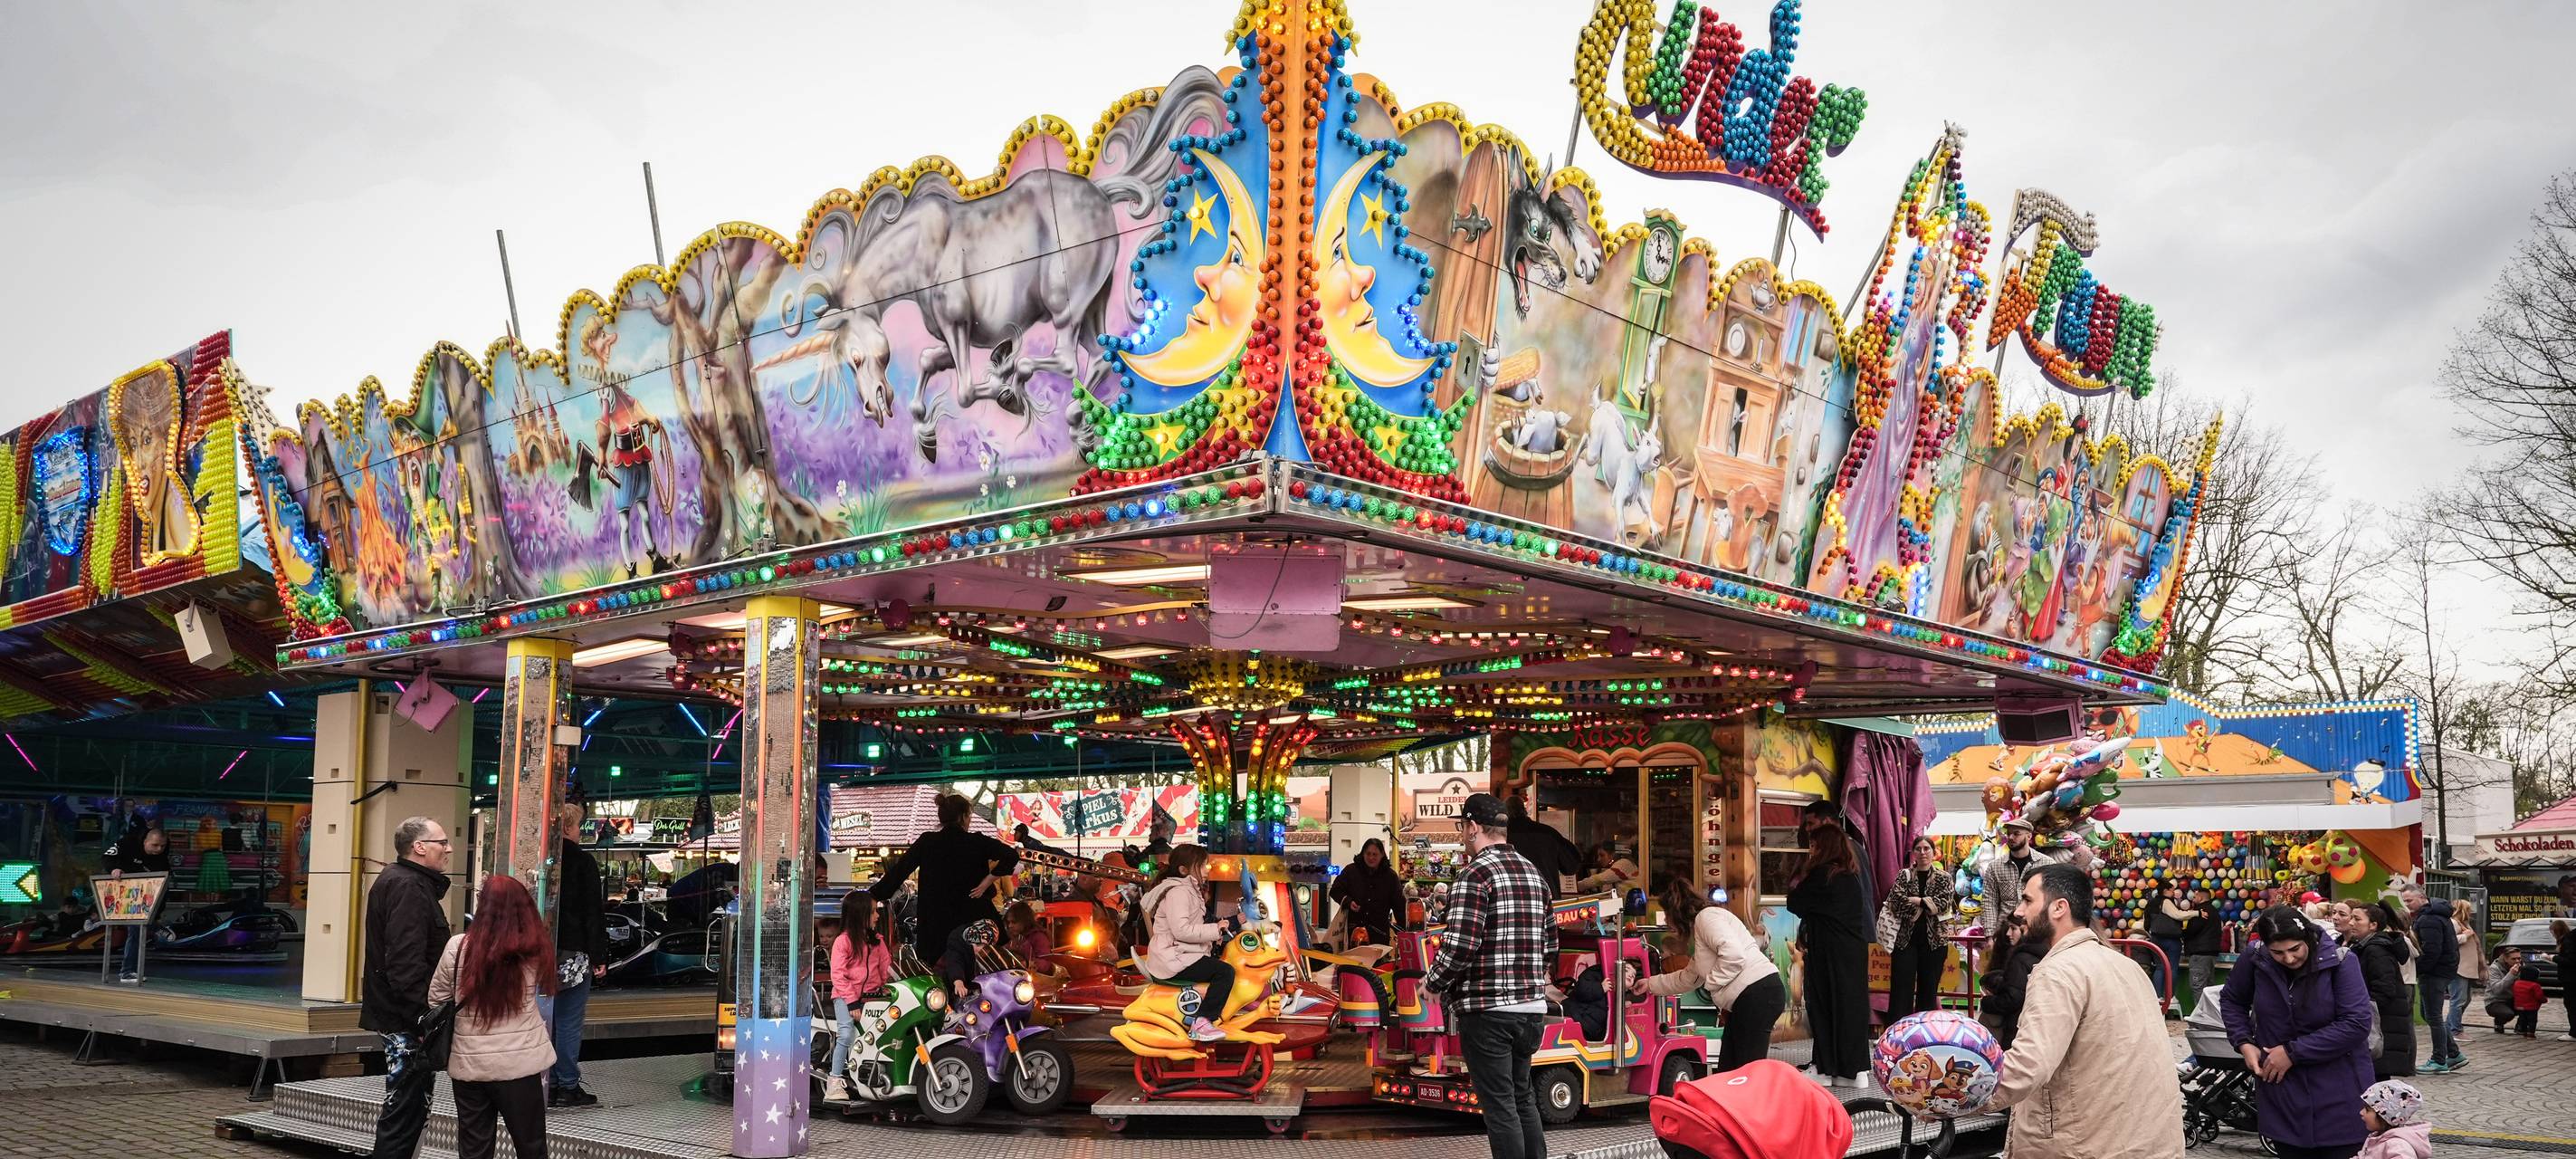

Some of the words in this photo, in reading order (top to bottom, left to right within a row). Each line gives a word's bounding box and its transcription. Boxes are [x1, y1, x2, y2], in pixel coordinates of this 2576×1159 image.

[1081, 797, 1107, 815] PIEL
[1418, 804, 1454, 817] WILD
[654, 819, 668, 830] Der
[669, 819, 685, 833] Grill
[1072, 809, 1118, 833] rkus
[2495, 835, 2575, 852] Schokoladen
[2490, 905, 2518, 913] LETZTEN
[2519, 905, 2533, 913] MAL
[2490, 913, 2511, 921] STOLZ
